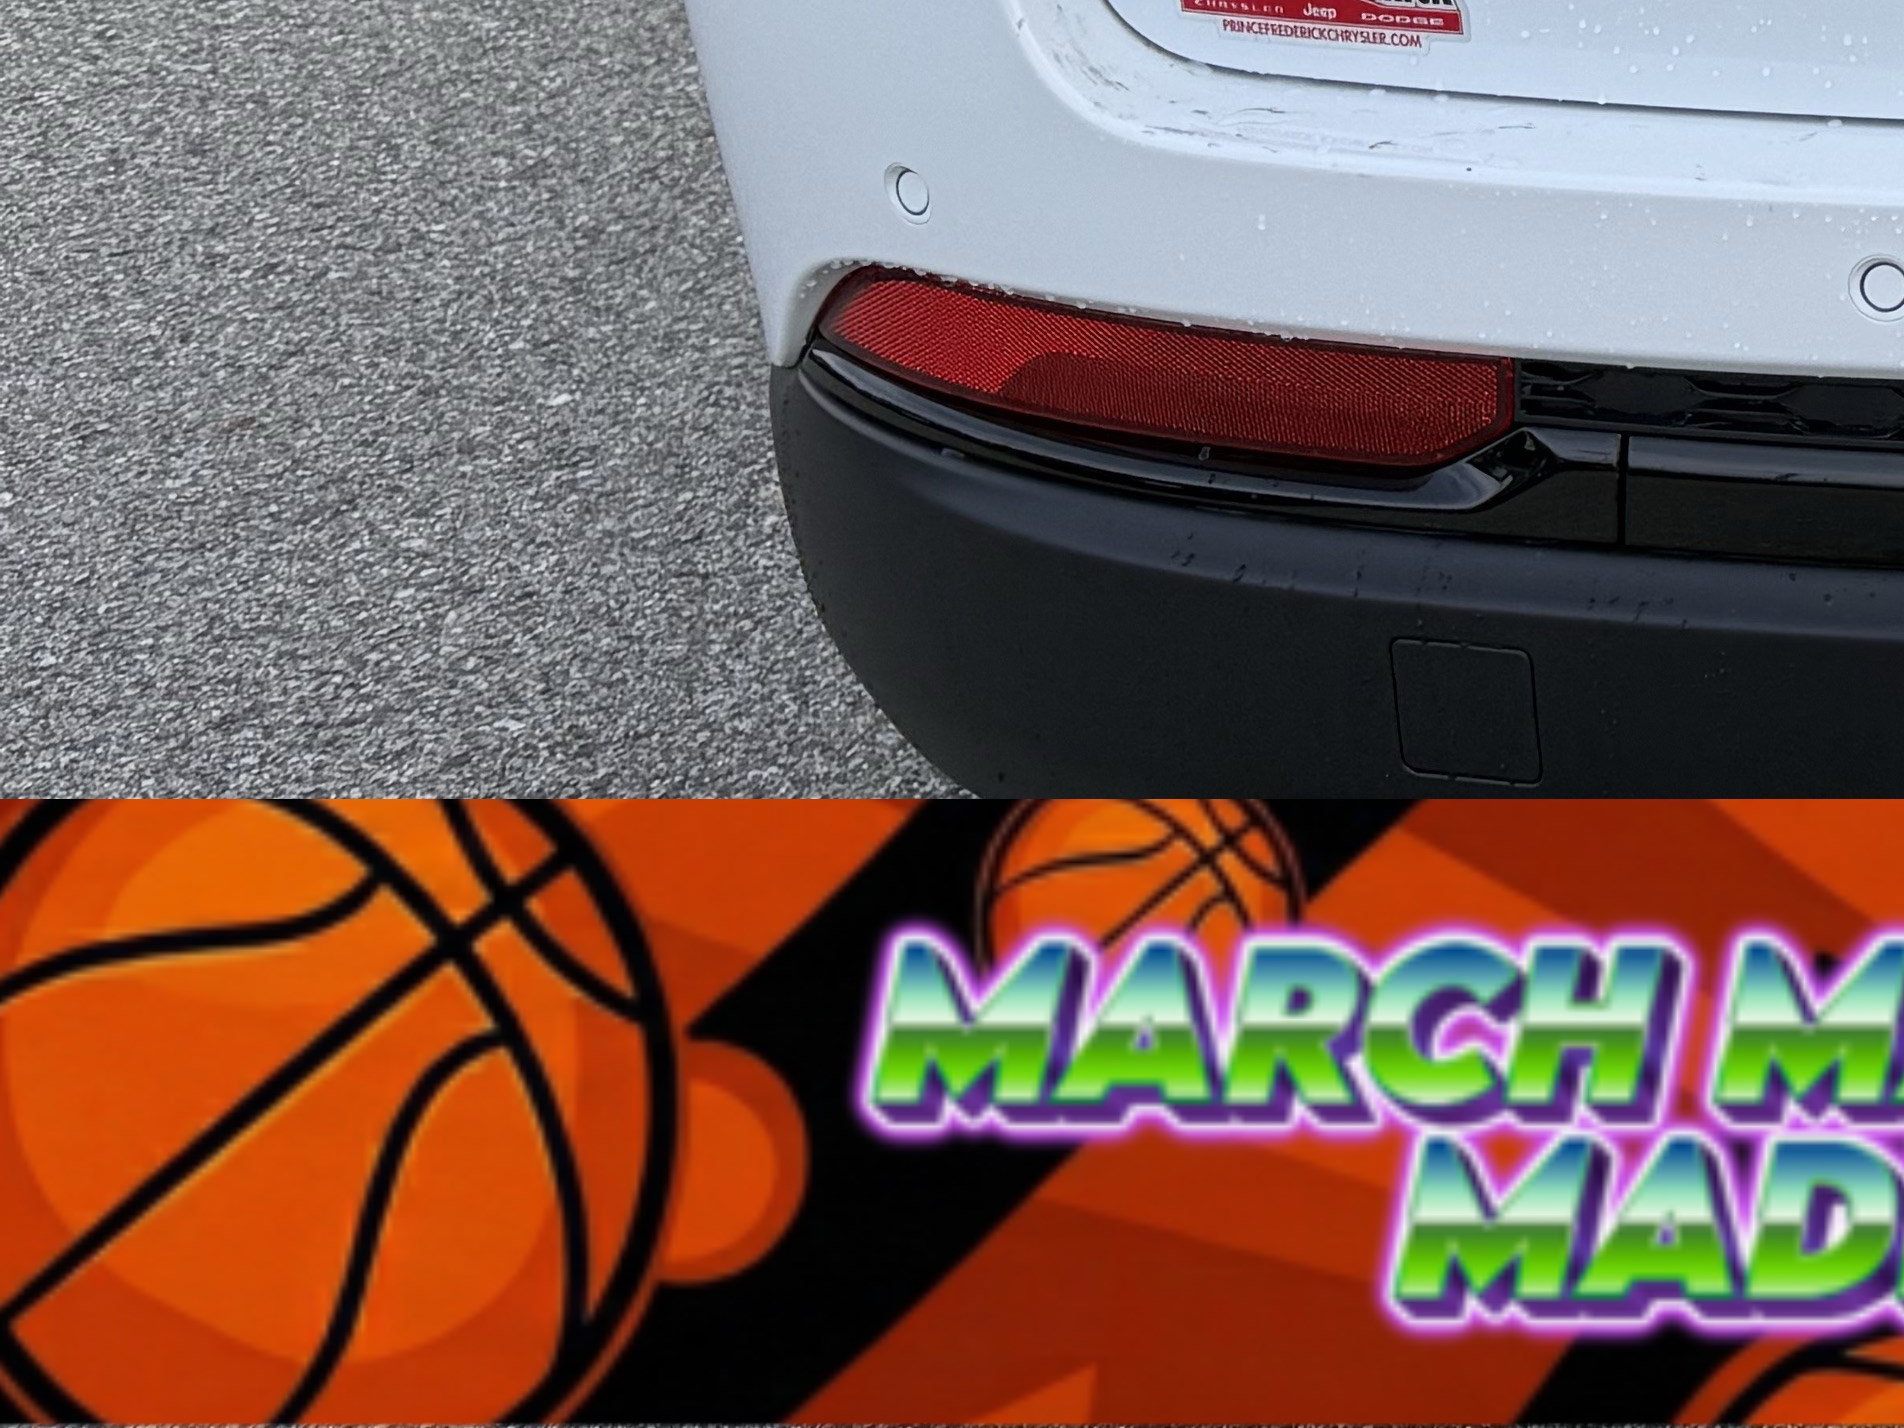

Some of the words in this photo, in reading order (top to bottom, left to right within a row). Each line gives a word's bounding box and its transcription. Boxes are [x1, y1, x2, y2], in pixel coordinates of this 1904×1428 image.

[1303, 2, 1337, 20] Jeep
[1360, 11, 1445, 26] DODGE
[1222, 18, 1423, 49] PRINCEFREDERICKCHRYSLER.COM
